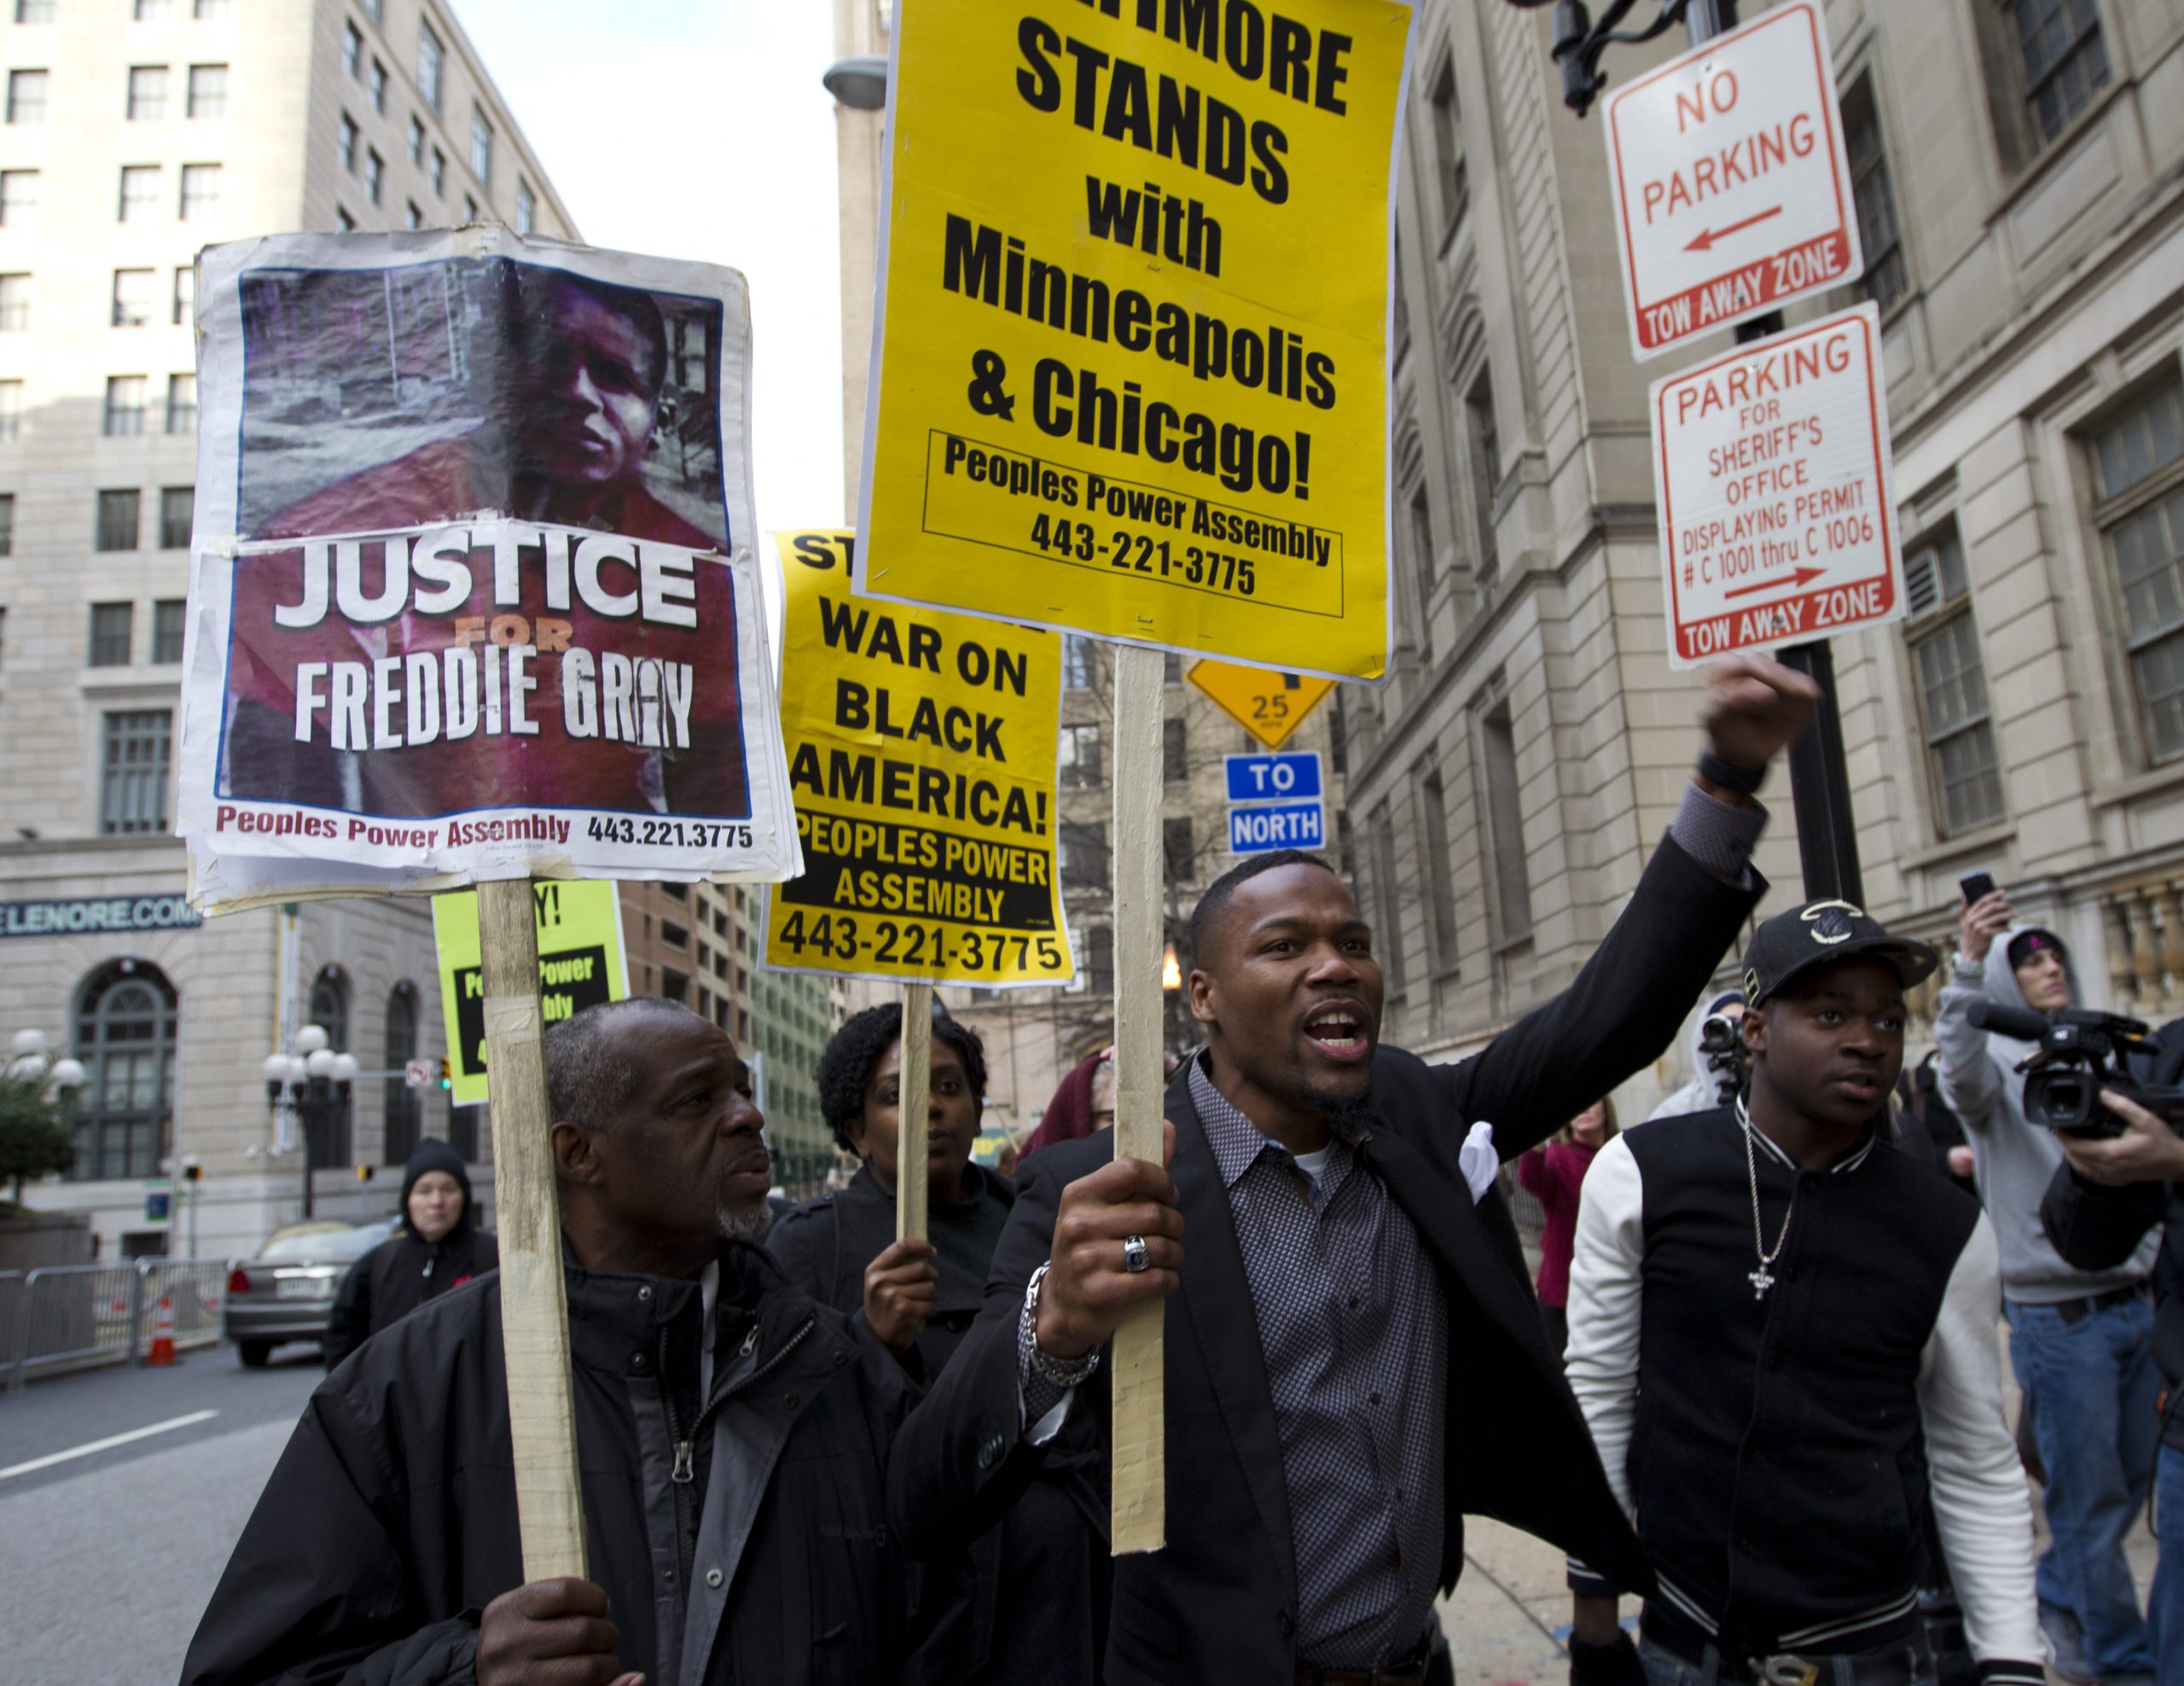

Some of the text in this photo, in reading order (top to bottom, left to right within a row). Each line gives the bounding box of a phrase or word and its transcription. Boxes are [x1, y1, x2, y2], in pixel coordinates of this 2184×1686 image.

[1016, 16, 1288, 205] STANDS
[1676, 69, 1738, 133] NO
[1643, 112, 1815, 225] PARKING
[1085, 174, 1222, 278] with
[943, 212, 1336, 410] Minneapolis
[1646, 237, 1843, 346] TOW AWAY ZONE
[1678, 334, 1850, 426] PARKING
[1740, 398, 1780, 430] FOR
[967, 349, 1311, 501] & Chicago!
[1709, 416, 1823, 478] SHERIFF'S
[944, 436, 1331, 567] Peoples Power Assembly
[1683, 480, 1865, 556] DISPLAYING PERMIT
[1726, 459, 1809, 506] OFFICE
[274, 529, 698, 630] JUSTICE
[793, 534, 854, 578] ST
[1031, 514, 1256, 596] 443-221-3775
[1684, 513, 1874, 590] # C 1001 thru C 1006
[454, 613, 574, 651] FOR
[818, 595, 1028, 697] WAR ON
[1685, 582, 1884, 657] TOW AWAY ZONE
[294, 644, 693, 751] FREDDIE GRAY
[834, 678, 1007, 764] BLACK
[1252, 695, 1289, 719] 25
[790, 742, 1048, 836] AMERICA!
[1248, 763, 1295, 792] TO
[216, 805, 753, 849] Peoples Power Assembly 443.221.3775
[796, 812, 1048, 887] PEOPLES POWER
[1234, 811, 1319, 845] NORTH
[834, 868, 1005, 923] ASSEMBLY
[779, 910, 1063, 973] 443-221-3775
